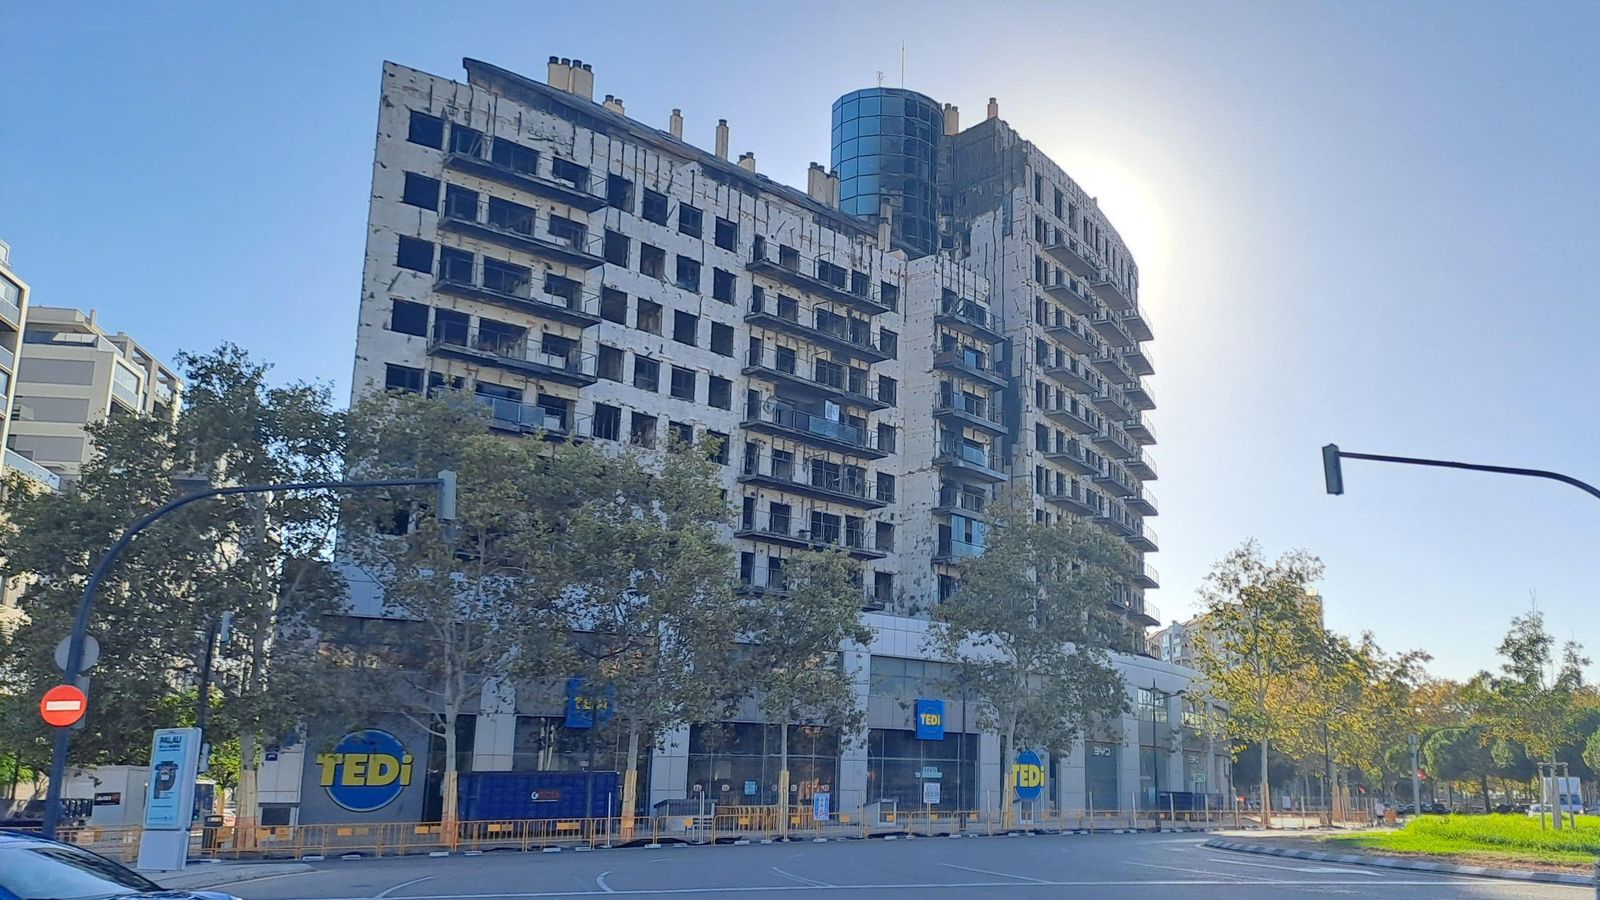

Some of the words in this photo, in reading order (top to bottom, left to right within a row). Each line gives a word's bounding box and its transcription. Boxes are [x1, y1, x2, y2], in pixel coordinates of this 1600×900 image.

[1093, 746, 1111, 757] BYD
[316, 753, 414, 787] TEDi
[1012, 764, 1045, 788] TEDi
